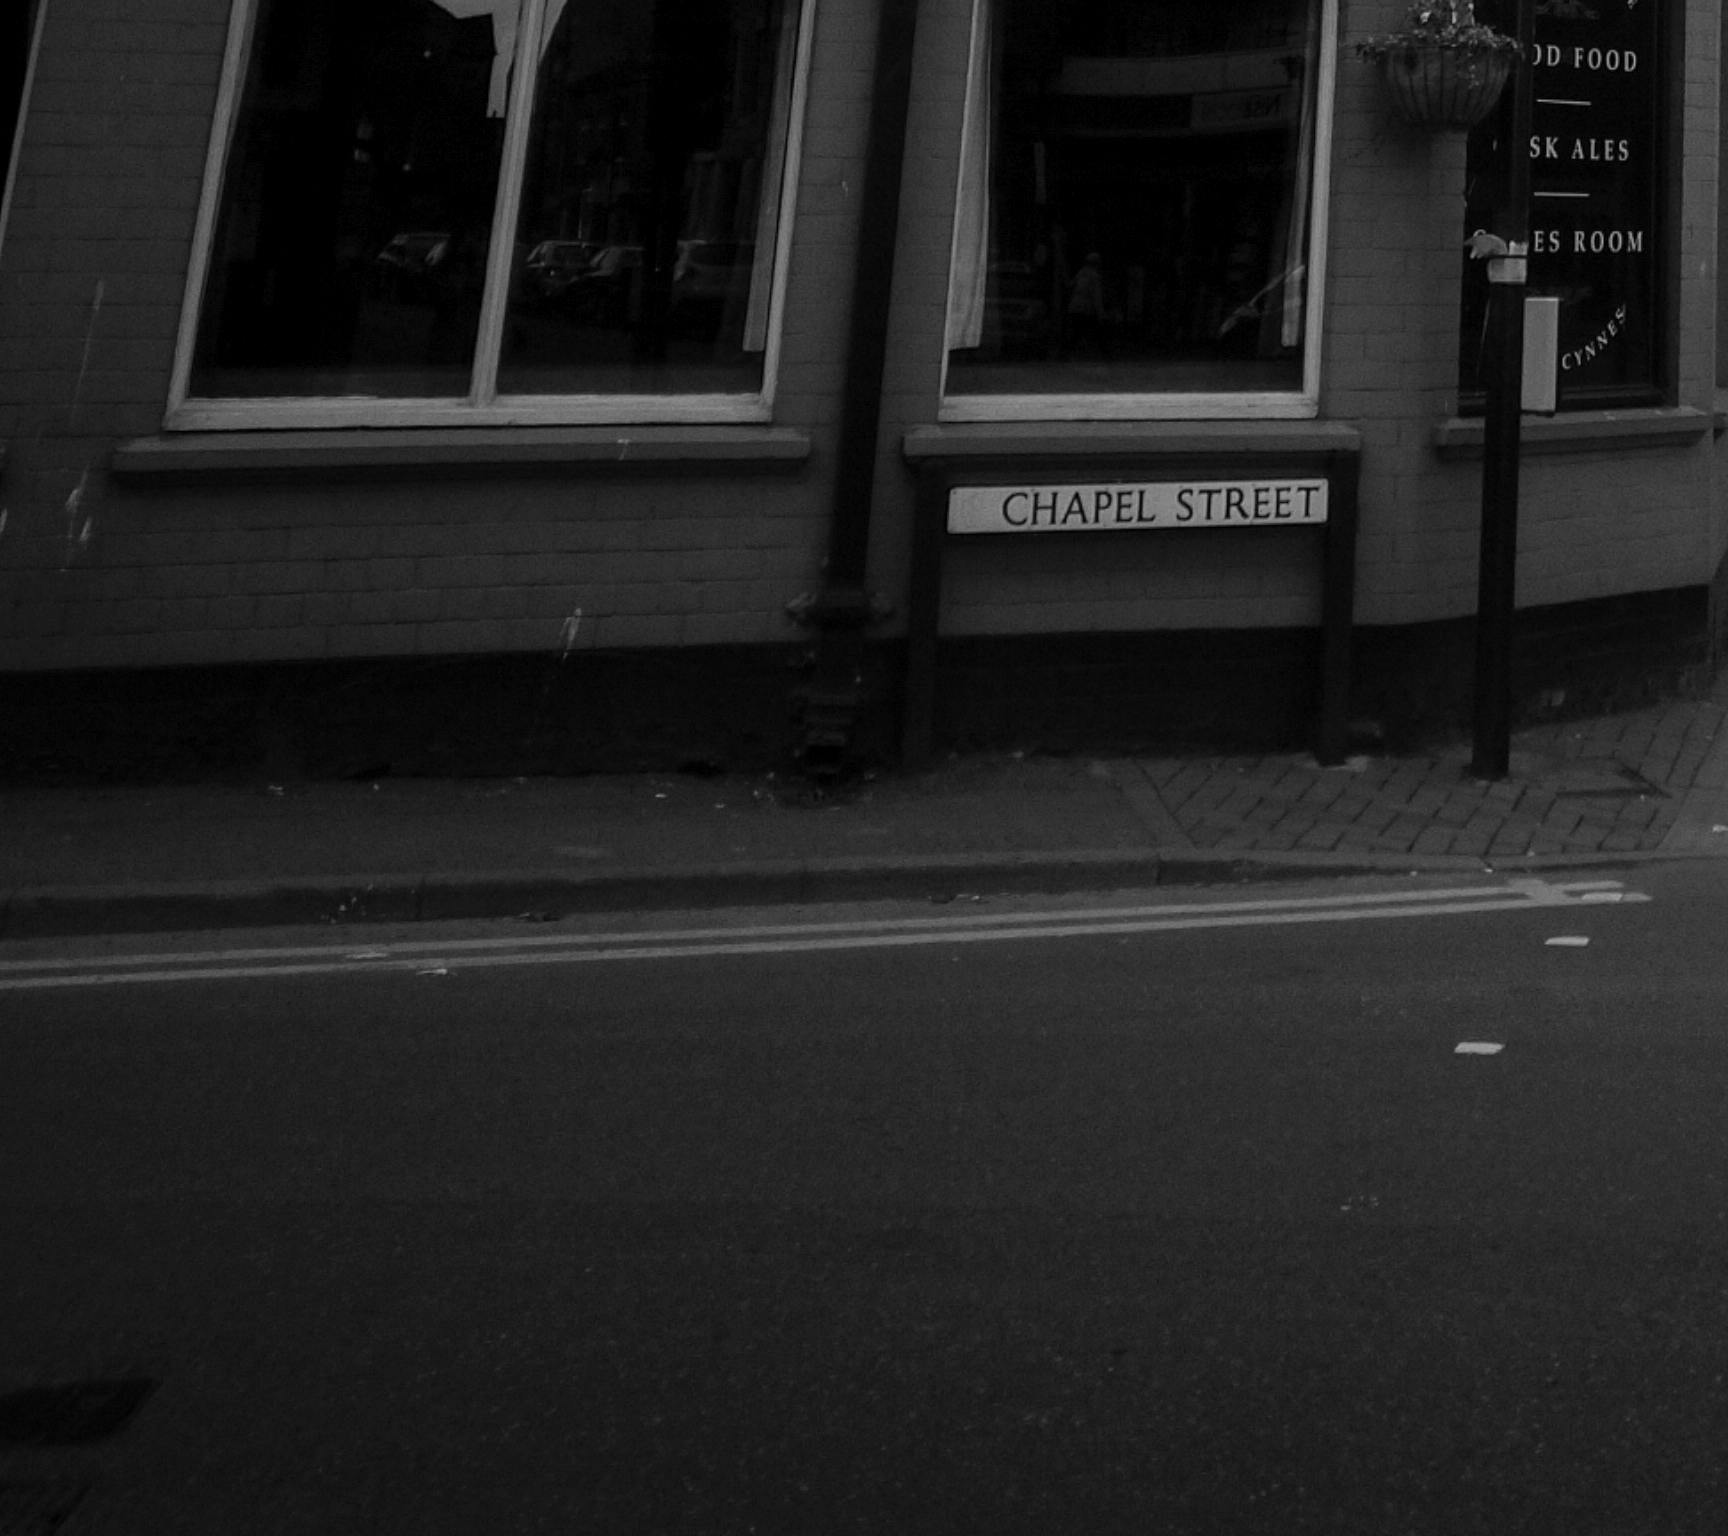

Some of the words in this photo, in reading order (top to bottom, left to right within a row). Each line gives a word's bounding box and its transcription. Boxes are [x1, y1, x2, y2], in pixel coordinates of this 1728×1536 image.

[1531, 44, 1562, 68] OD
[1573, 47, 1638, 73] FOOD
[1529, 135, 1561, 160] SK
[1570, 137, 1631, 162] ALES
[1573, 230, 1644, 254] ROOM
[1002, 490, 1156, 526] CHAPEL
[1176, 486, 1319, 522] STREET
